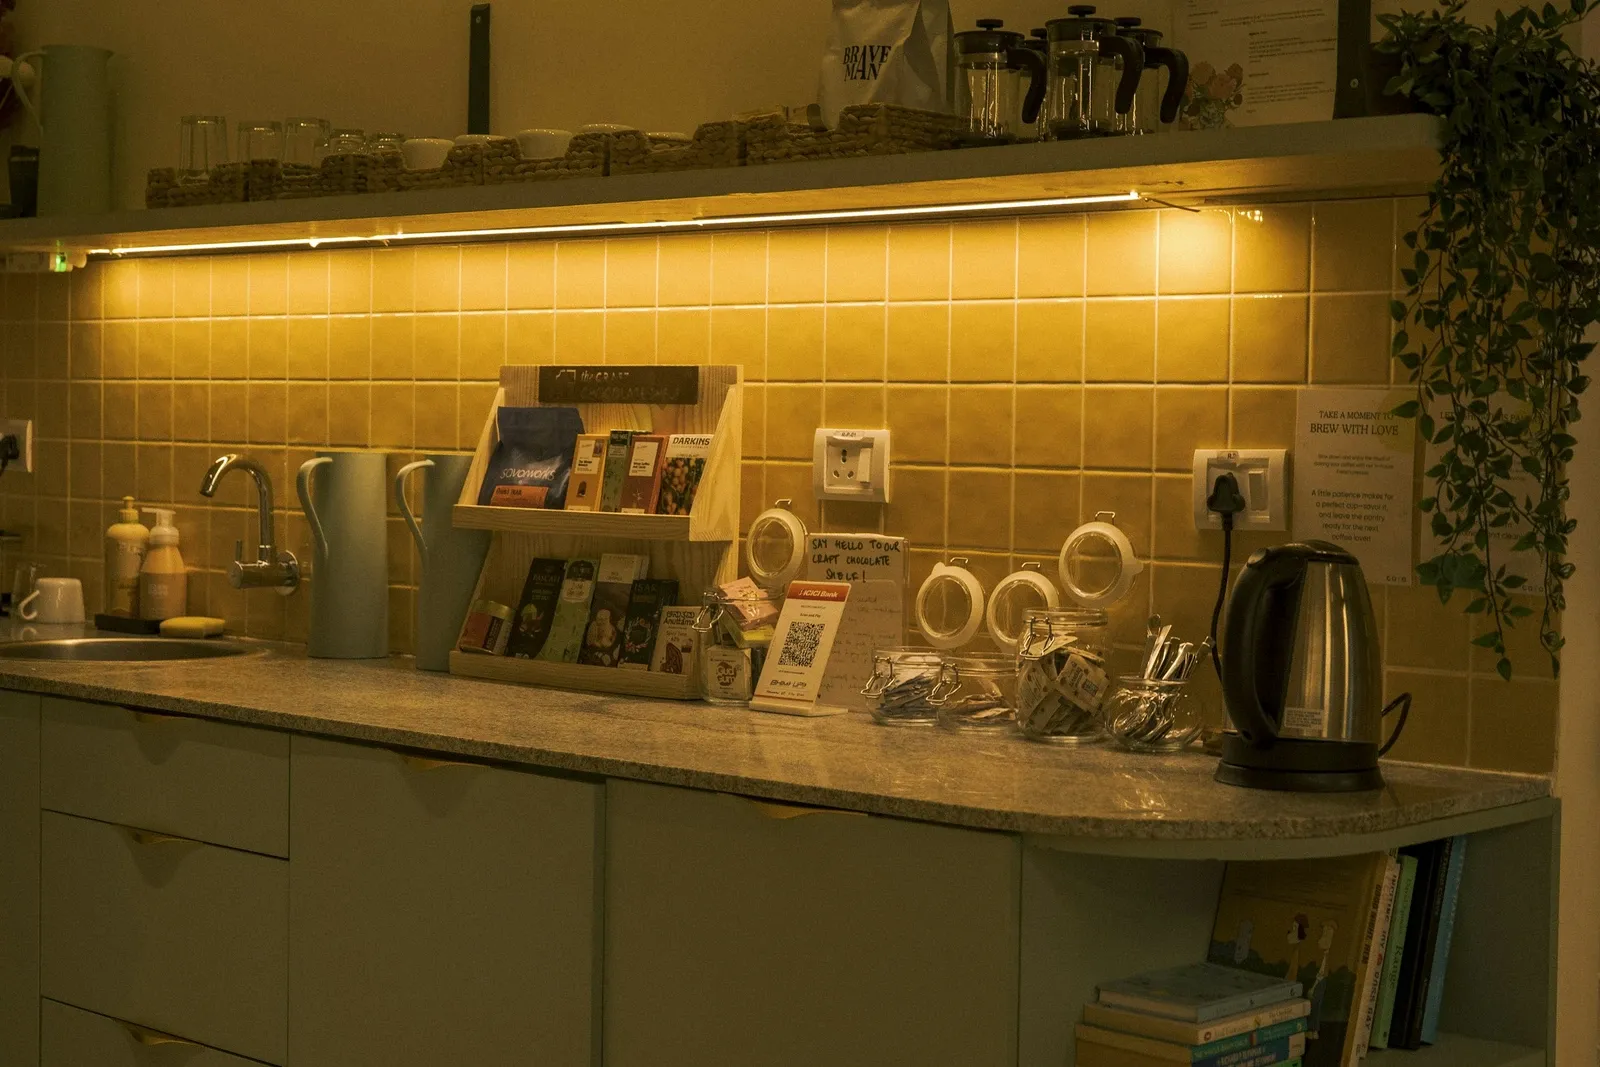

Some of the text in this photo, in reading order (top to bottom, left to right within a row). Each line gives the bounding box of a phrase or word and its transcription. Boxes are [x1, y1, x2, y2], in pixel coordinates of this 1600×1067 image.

[843, 45, 892, 64] BRAVE
[844, 63, 882, 81] MAN
[1319, 411, 1338, 419] TAKE
[1340, 411, 1346, 419] A
[1347, 411, 1382, 421] MOMENT
[1310, 423, 1399, 436] BREW WITH LOVE
[672, 437, 711, 446] DARKINS
[1332, 491, 1361, 500] patience
[1322, 501, 1345, 509] perfect
[1333, 511, 1351, 520] leave
[1352, 512, 1363, 520] the
[1364, 513, 1386, 522] pantry
[812, 539, 900, 552] SAY HELLO TO OUR
[812, 554, 890, 566] CRAFT CHOCOLATE
[802, 589, 839, 598] ICICI Bank
